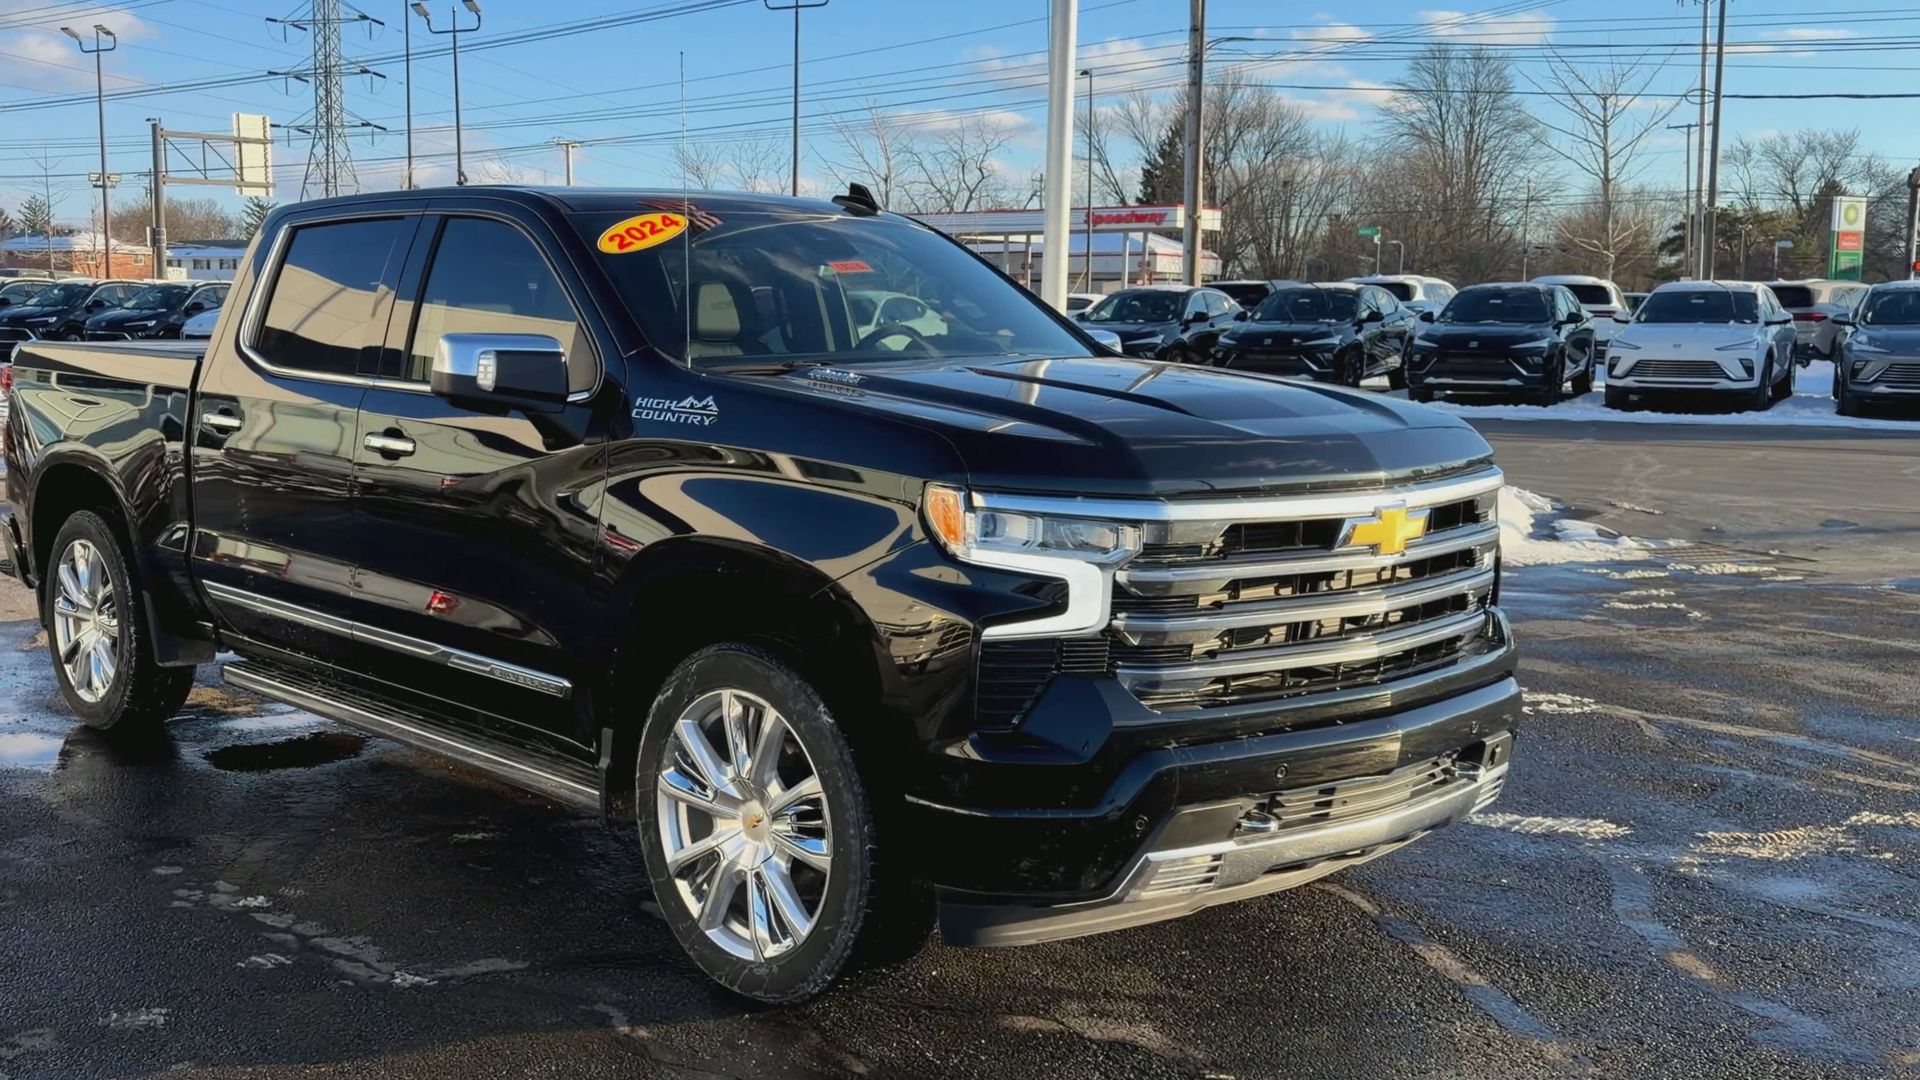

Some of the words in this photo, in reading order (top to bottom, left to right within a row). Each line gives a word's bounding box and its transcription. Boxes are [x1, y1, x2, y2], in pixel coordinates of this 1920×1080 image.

[1084, 208, 1168, 227] Speedway
[608, 215, 681, 250] 2024
[635, 397, 678, 409] HIGH
[631, 408, 717, 426] COUNTRY
